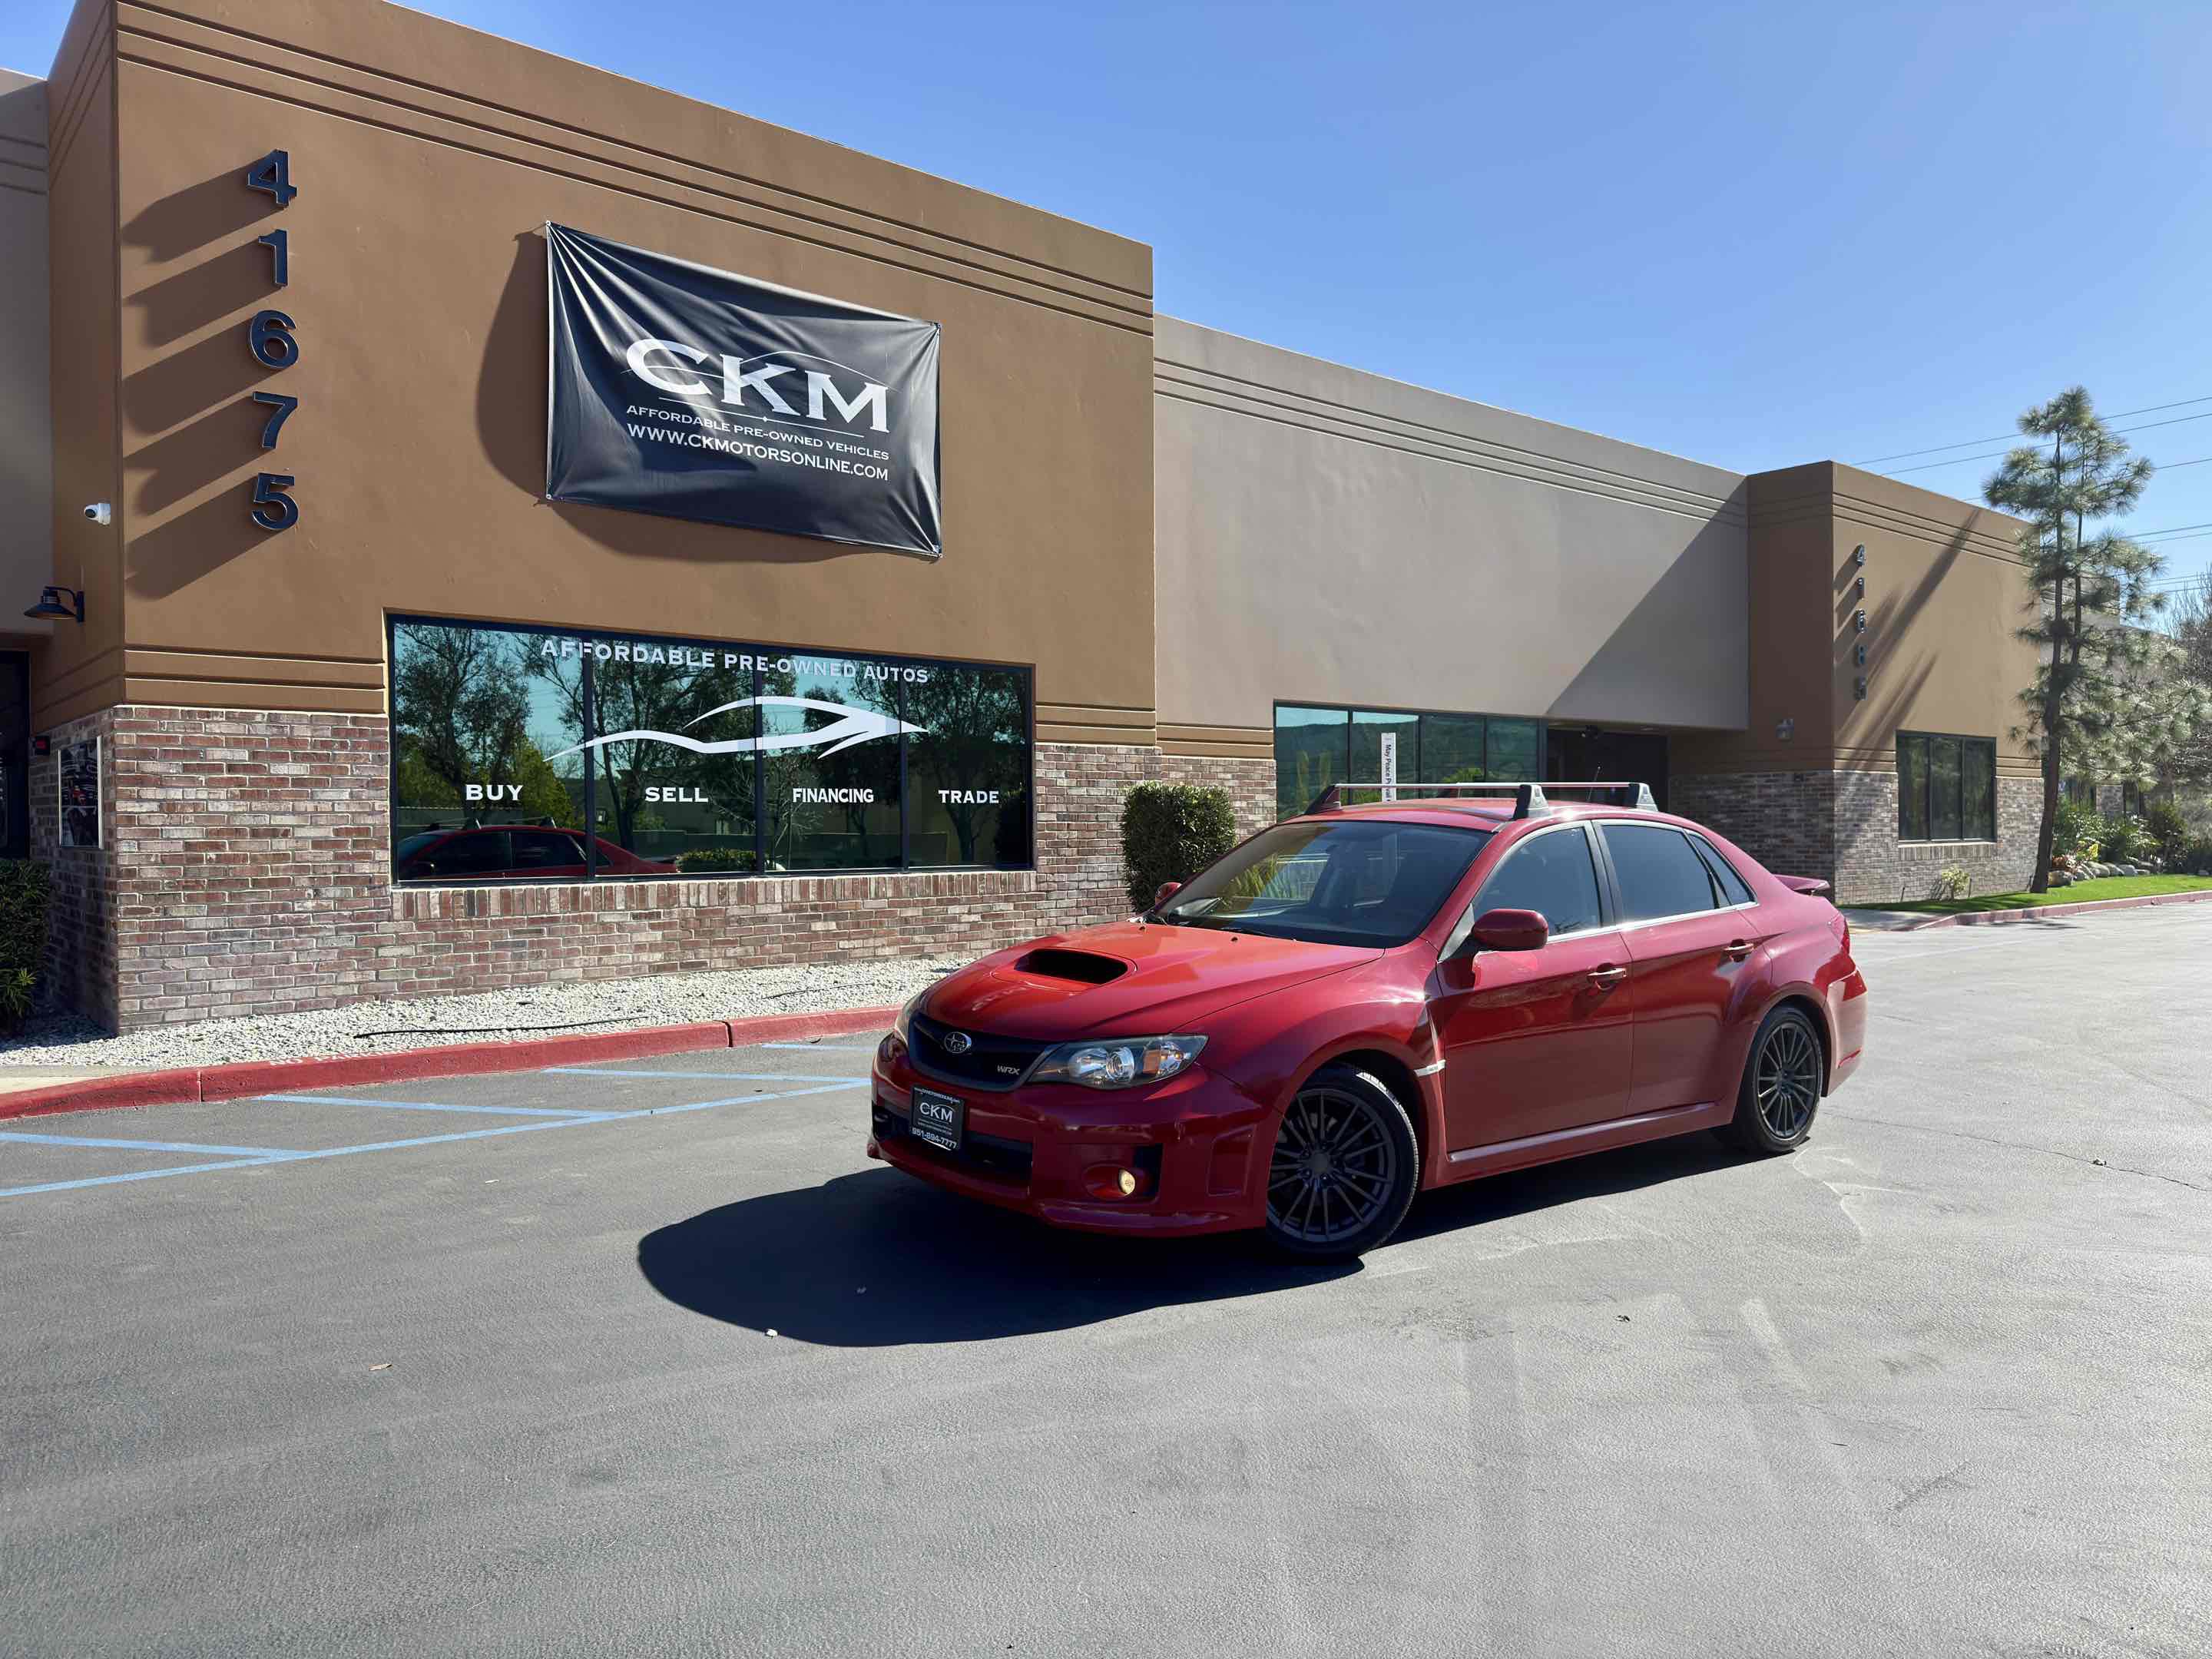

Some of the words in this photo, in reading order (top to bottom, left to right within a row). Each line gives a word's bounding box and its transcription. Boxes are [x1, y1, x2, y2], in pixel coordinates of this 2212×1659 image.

[247, 148, 300, 530] 41675
[626, 338, 889, 433] CKM
[626, 405, 730, 432] AFFORDABLE
[733, 424, 823, 448] PRE-OWNED
[826, 441, 889, 461] VEHICLES
[627, 423, 889, 481] WWW.CKMOTORSONLINE.COM
[540, 639, 716, 668] AFFORDABLE
[724, 653, 856, 677] PRE-OWNED
[863, 664, 929, 684] AUTOS
[465, 784, 523, 800] BUY
[644, 786, 709, 803] SELL
[792, 788, 874, 803] FINANCING
[938, 790, 999, 804] TRADE
[996, 1065, 1021, 1075] WRX
[919, 1101, 952, 1123] CKM
